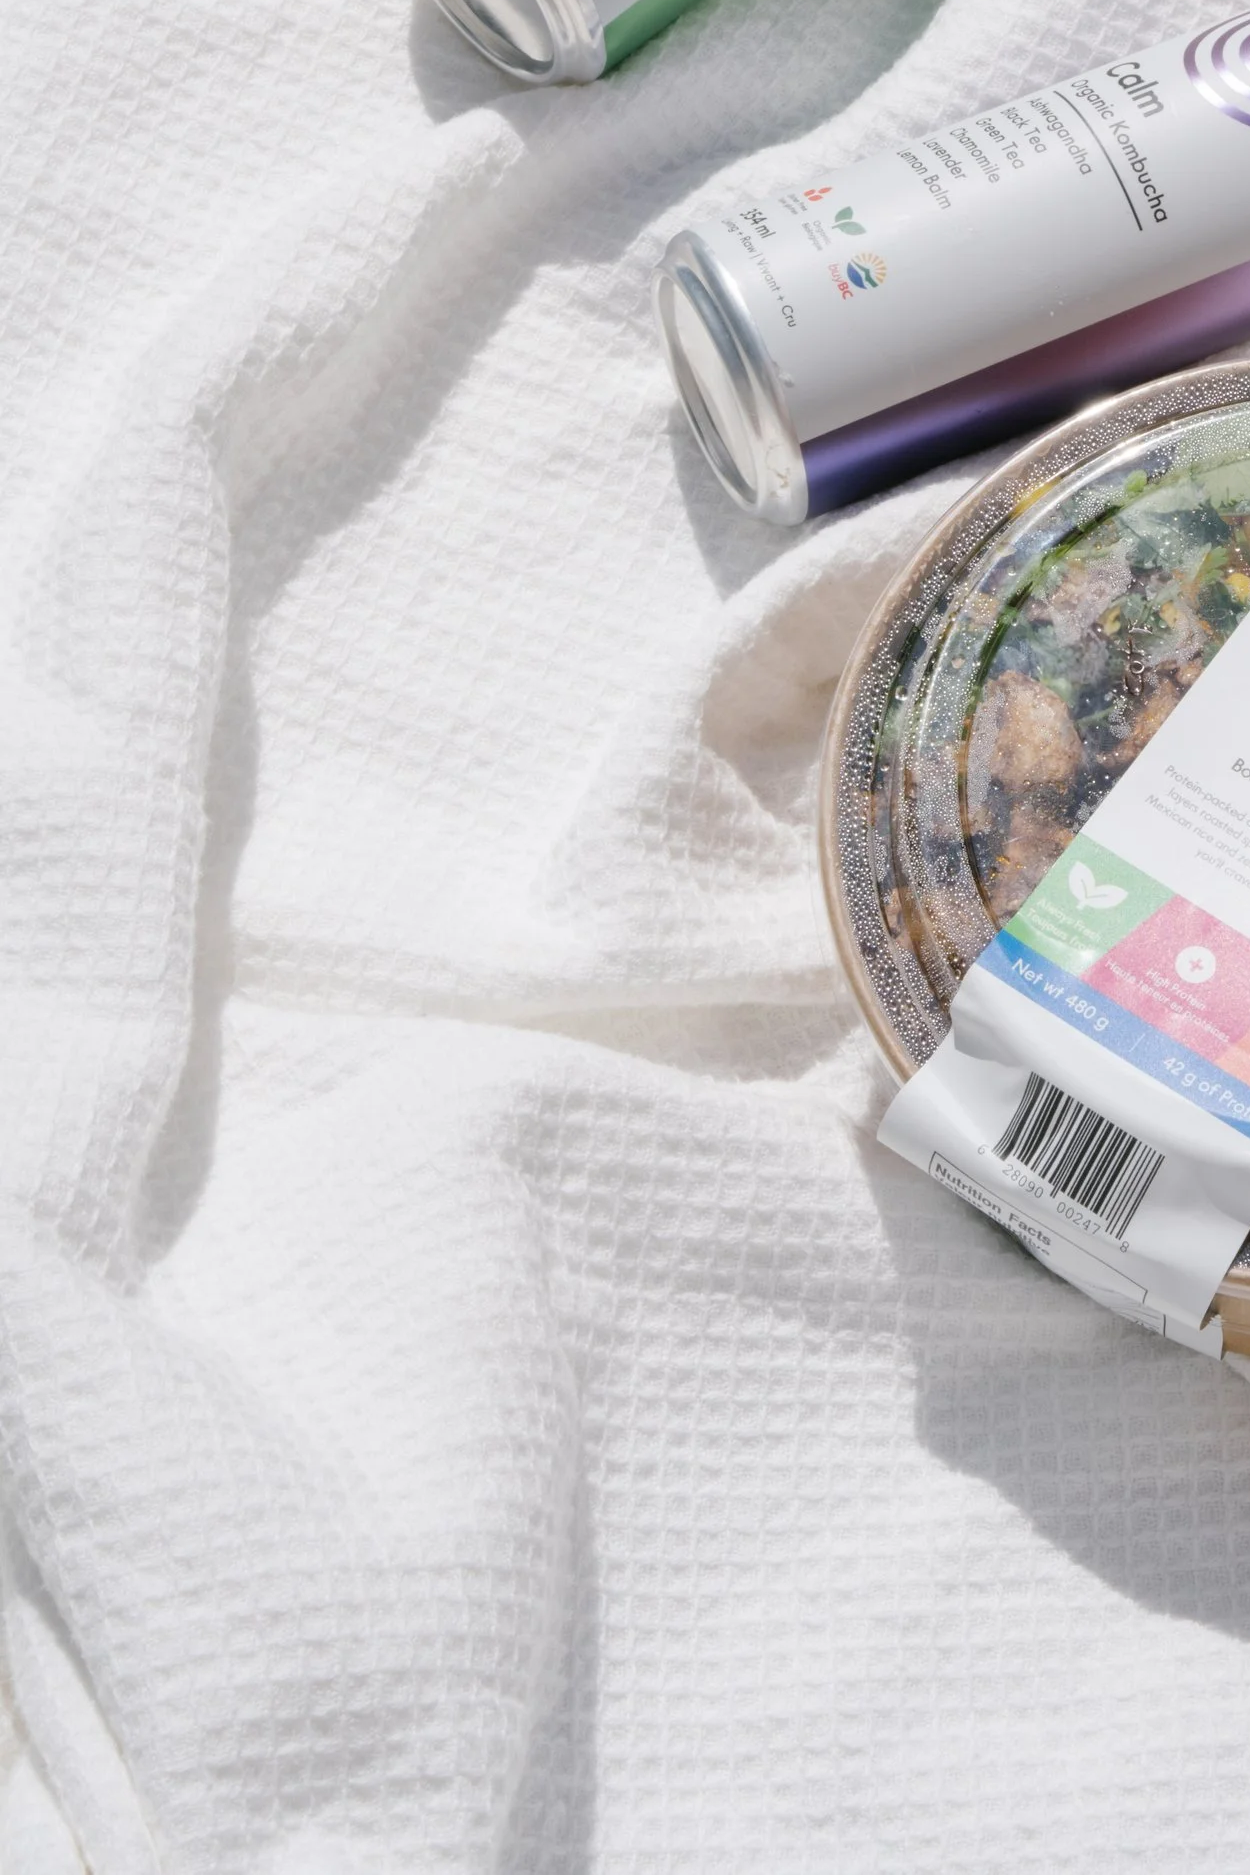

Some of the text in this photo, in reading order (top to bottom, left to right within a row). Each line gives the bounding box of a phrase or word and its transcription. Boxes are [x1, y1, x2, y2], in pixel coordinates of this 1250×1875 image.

[1106, 61, 1165, 119] Calm
[949, 127, 1000, 184] Chamomile
[975, 117, 1025, 170] Green Tea
[1000, 107, 1046, 154] Black Tea
[1026, 97, 1093, 176] Ashwagandha
[1070, 78, 1168, 223] Organic Kombucha
[922, 137, 968, 182] Lavender
[922, 171, 952, 211] Balm
[740, 208, 776, 239] 354 ml
[741, 235, 757, 254] Raw
[756, 253, 781, 292] Vivant
[781, 305, 796, 328] Cru
[1164, 764, 1248, 825] Protein-packed
[1167, 786, 1198, 813] layers
[1198, 806, 1242, 840] roasted
[1144, 793, 1195, 833] Mexican
[1193, 822, 1215, 844] rice
[1214, 834, 1239, 857] and
[1105, 959, 1142, 986] Haute
[1138, 980, 1174, 1009] teneur
[1170, 1000, 1185, 1014] en
[1146, 966, 1206, 1011] High Protein
[1011, 957, 1044, 987] Net
[1042, 977, 1066, 998] wt
[1066, 990, 1097, 1020] 480
[1094, 1012, 1111, 1032] g
[1163, 1055, 1186, 1077] 42
[1182, 1070, 1198, 1088] g
[1198, 1078, 1221, 1096] of
[935, 1163, 1052, 1246] Nutrition Facts
[977, 1144, 1130, 1253] 6 28090 00247 8
